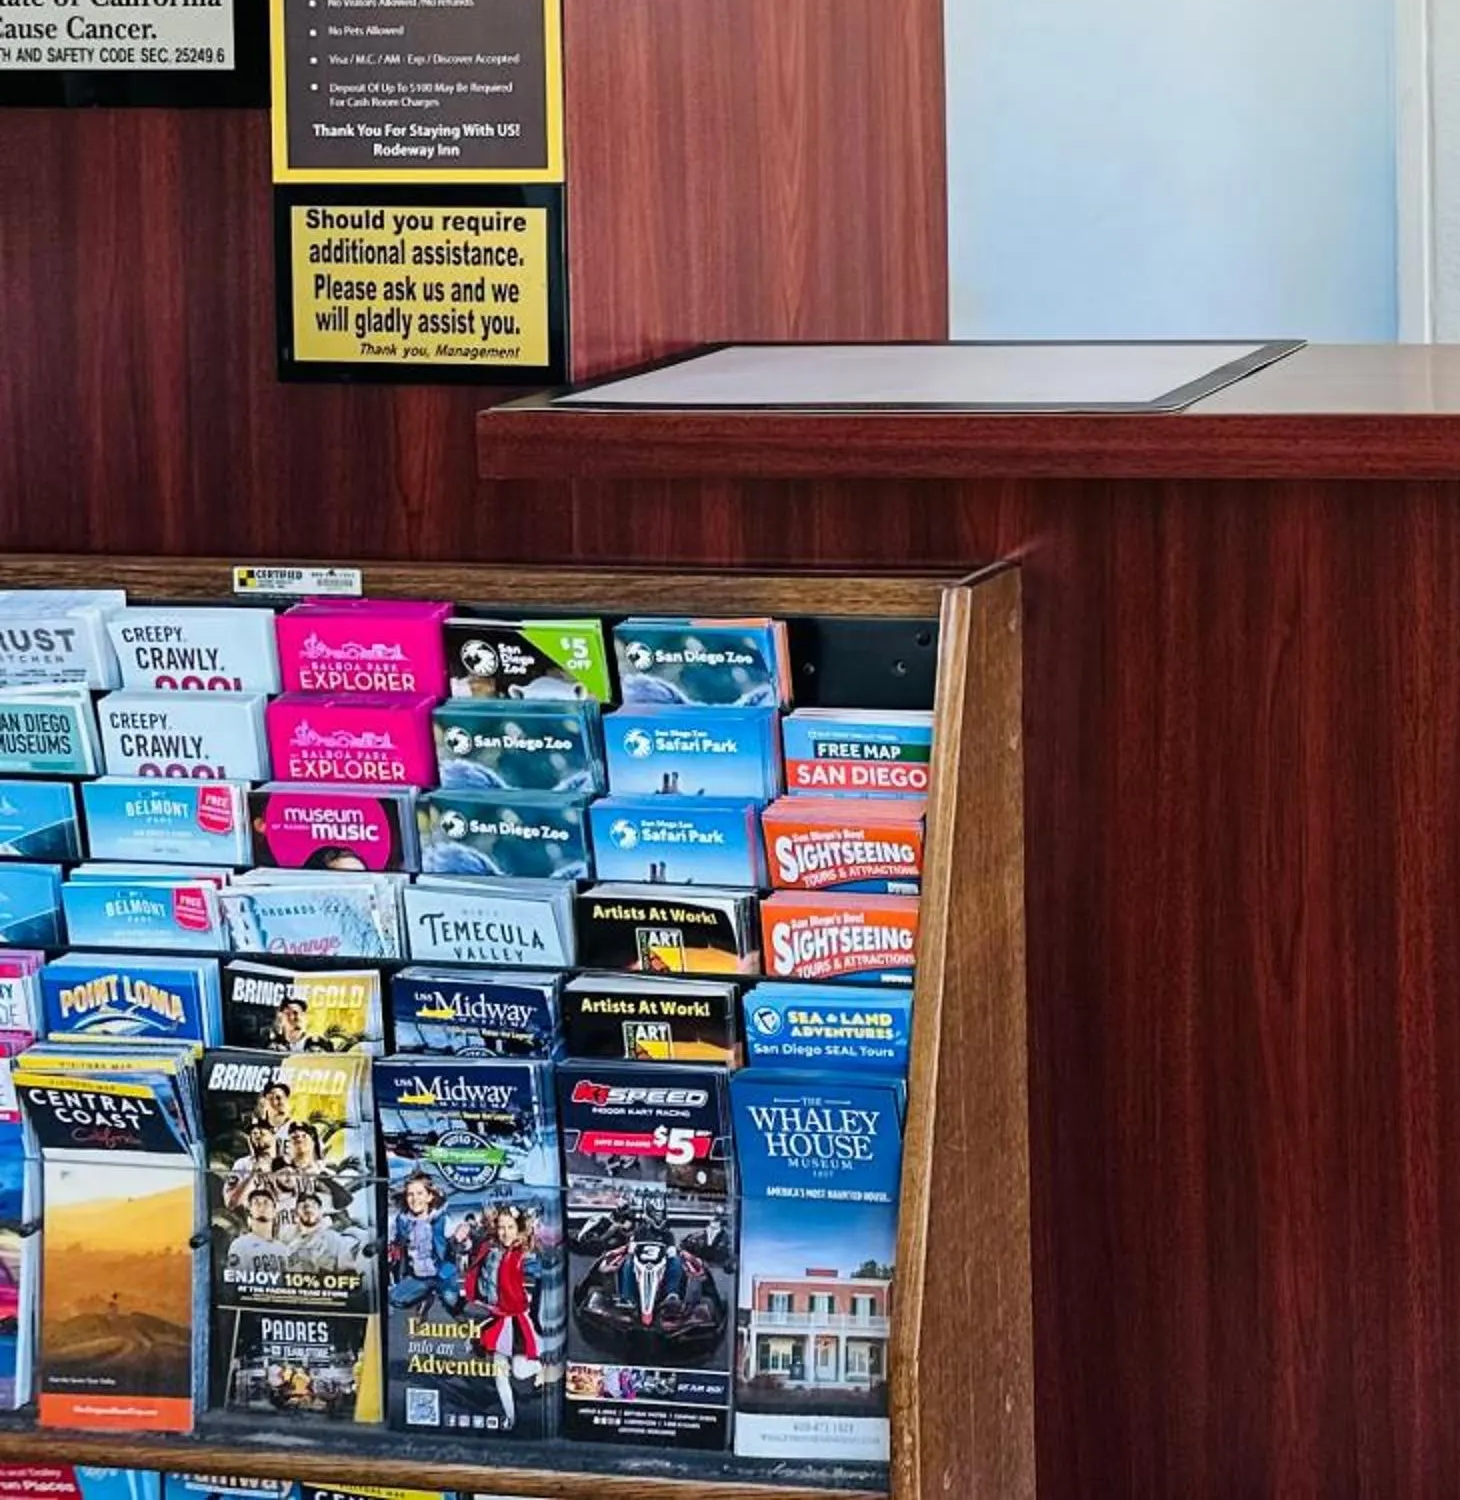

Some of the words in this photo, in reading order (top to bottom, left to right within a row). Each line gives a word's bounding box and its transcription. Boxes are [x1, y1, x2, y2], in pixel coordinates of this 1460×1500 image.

[66, 15, 158, 40] Cancer.
[328, 26, 343, 36] No
[343, 26, 365, 36] Pets
[365, 25, 404, 35] Allowed
[15, 47, 42, 63] AND
[47, 47, 94, 63] SAFETY
[99, 47, 135, 63] CODE
[313, 123, 355, 137] Thank
[357, 124, 382, 137] You
[385, 124, 407, 137] For
[409, 124, 461, 140] Staying
[462, 124, 495, 137] With
[496, 124, 520, 137] US!
[373, 143, 434, 159] Rodeway
[437, 143, 460, 157] Inn
[305, 209, 386, 231] Should
[393, 214, 434, 235] you
[442, 212, 527, 236] require
[309, 238, 406, 265] additional
[412, 240, 525, 267] assistance.
[314, 274, 377, 301] Please
[383, 275, 417, 301] ask
[423, 282, 445, 302] us
[450, 276, 485, 303] and
[491, 283, 519, 303] we
[315, 306, 349, 332] will
[355, 306, 413, 339] gladly
[417, 309, 475, 333] assist
[480, 315, 521, 341] you.
[360, 343, 398, 357] Thank
[402, 345, 431, 359] you,
[434, 345, 520, 360] Management
[560, 636, 589, 659] $5
[655, 649, 683, 664] San
[685, 651, 724, 665] Diego
[725, 651, 753, 664] Zoo
[135, 647, 226, 672] CRAWLY.
[567, 659, 592, 670] OFF
[300, 671, 416, 692] EXPLORER
[25, 713, 70, 733] DIEGO
[120, 733, 210, 760] CRAWLY.
[473, 735, 501, 748] San
[503, 736, 543, 751] Diego
[544, 737, 573, 750] Zoo
[655, 739, 700, 752] Safari
[702, 740, 738, 753] Park
[817, 742, 861, 758] FREE
[864, 745, 901, 760] MAP
[289, 759, 405, 781] EXPLORER
[797, 765, 846, 786] SAN
[851, 766, 928, 789] DIEGO
[125, 800, 189, 818] BELMONT
[284, 807, 365, 823] museum
[311, 824, 380, 842] music
[775, 834, 915, 883] SIGHTSEEING
[592, 904, 646, 921] Artists
[649, 907, 668, 922] At
[669, 908, 718, 925] Work!
[419, 912, 545, 950] TEMECULA
[647, 930, 679, 947] ART
[453, 946, 524, 962] VALLEY
[772, 922, 913, 976] SIGHTSEEING
[59, 974, 119, 1019] POINT
[122, 975, 187, 1024] LOMA
[232, 976, 285, 1007] BRING
[310, 984, 366, 1010] GOLD
[432, 991, 533, 1027] Midway
[787, 1010, 823, 1025] SEA
[839, 1012, 893, 1027] LAND
[791, 1026, 894, 1040] ADVENTURES
[753, 1043, 779, 1055] San
[782, 1044, 822, 1058] Diego
[825, 1045, 857, 1057] SEAL
[860, 1046, 895, 1058] Tours
[207, 1063, 272, 1092] BRING
[28, 1088, 154, 1116] CENTRAL
[412, 1075, 513, 1109] Midway
[54, 1107, 141, 1130] COAST
[746, 1105, 881, 1136] WHALEY
[764, 1131, 874, 1161] HOUSE
[787, 1157, 853, 1170] MUSEUM
[223, 1269, 281, 1286] ENJOY
[284, 1272, 320, 1288] 10%
[323, 1274, 362, 1290] OFF
[261, 1317, 329, 1343] PADRES
[407, 1317, 481, 1339] Launch
